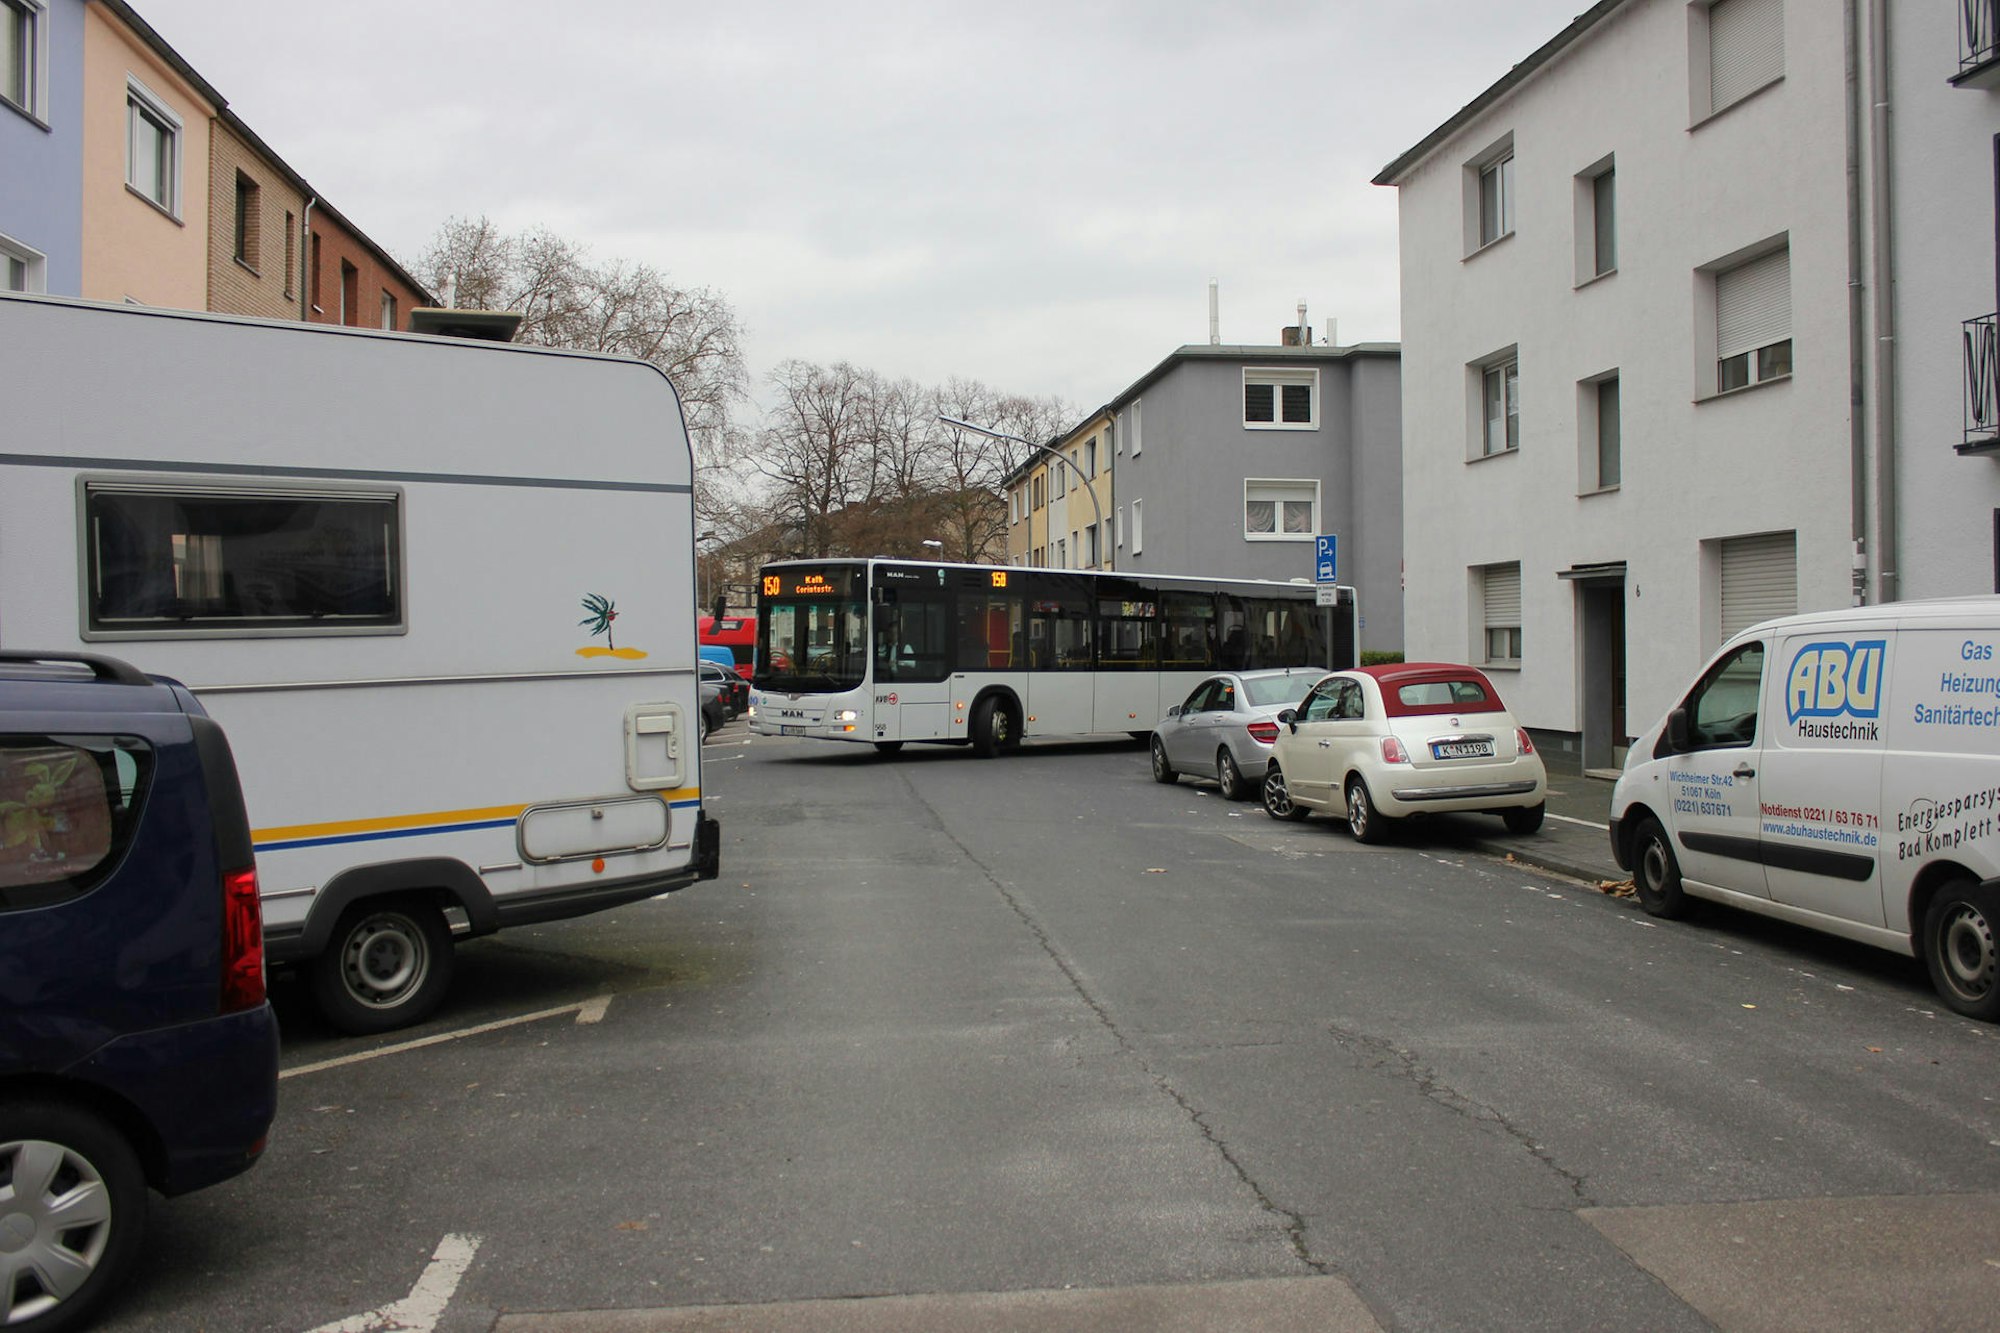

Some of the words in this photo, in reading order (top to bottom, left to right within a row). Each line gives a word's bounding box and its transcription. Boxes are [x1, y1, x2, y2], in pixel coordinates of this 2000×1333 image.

[1319, 538, 1328, 557] P
[763, 576, 780, 596] 150
[991, 572, 1006, 587] 150
[1636, 584, 1640, 597] 6
[1961, 640, 1992, 660] Gas
[1787, 643, 1884, 722] ABU
[781, 710, 803, 718] MAN
[1799, 720, 1878, 740] Haustechnik
[1670, 771, 1709, 784] Wichheimer
[1711, 776, 1733, 786] Str.42
[1681, 786, 1702, 798] 51067
[1704, 787, 1721, 799] Köln
[1674, 799, 1699, 814] (0221)
[1701, 803, 1731, 816] 637671
[1761, 803, 1802, 820] Notdienst
[1804, 808, 1826, 821] 0221
[1835, 811, 1848, 824] 63
[1850, 813, 1863, 826] 76
[1866, 815, 1878, 828] 71
[1763, 822, 1877, 846] www.abuhaustechnik.de
[1899, 837, 1920, 860] Bad
[1926, 818, 1992, 853] Komplett
